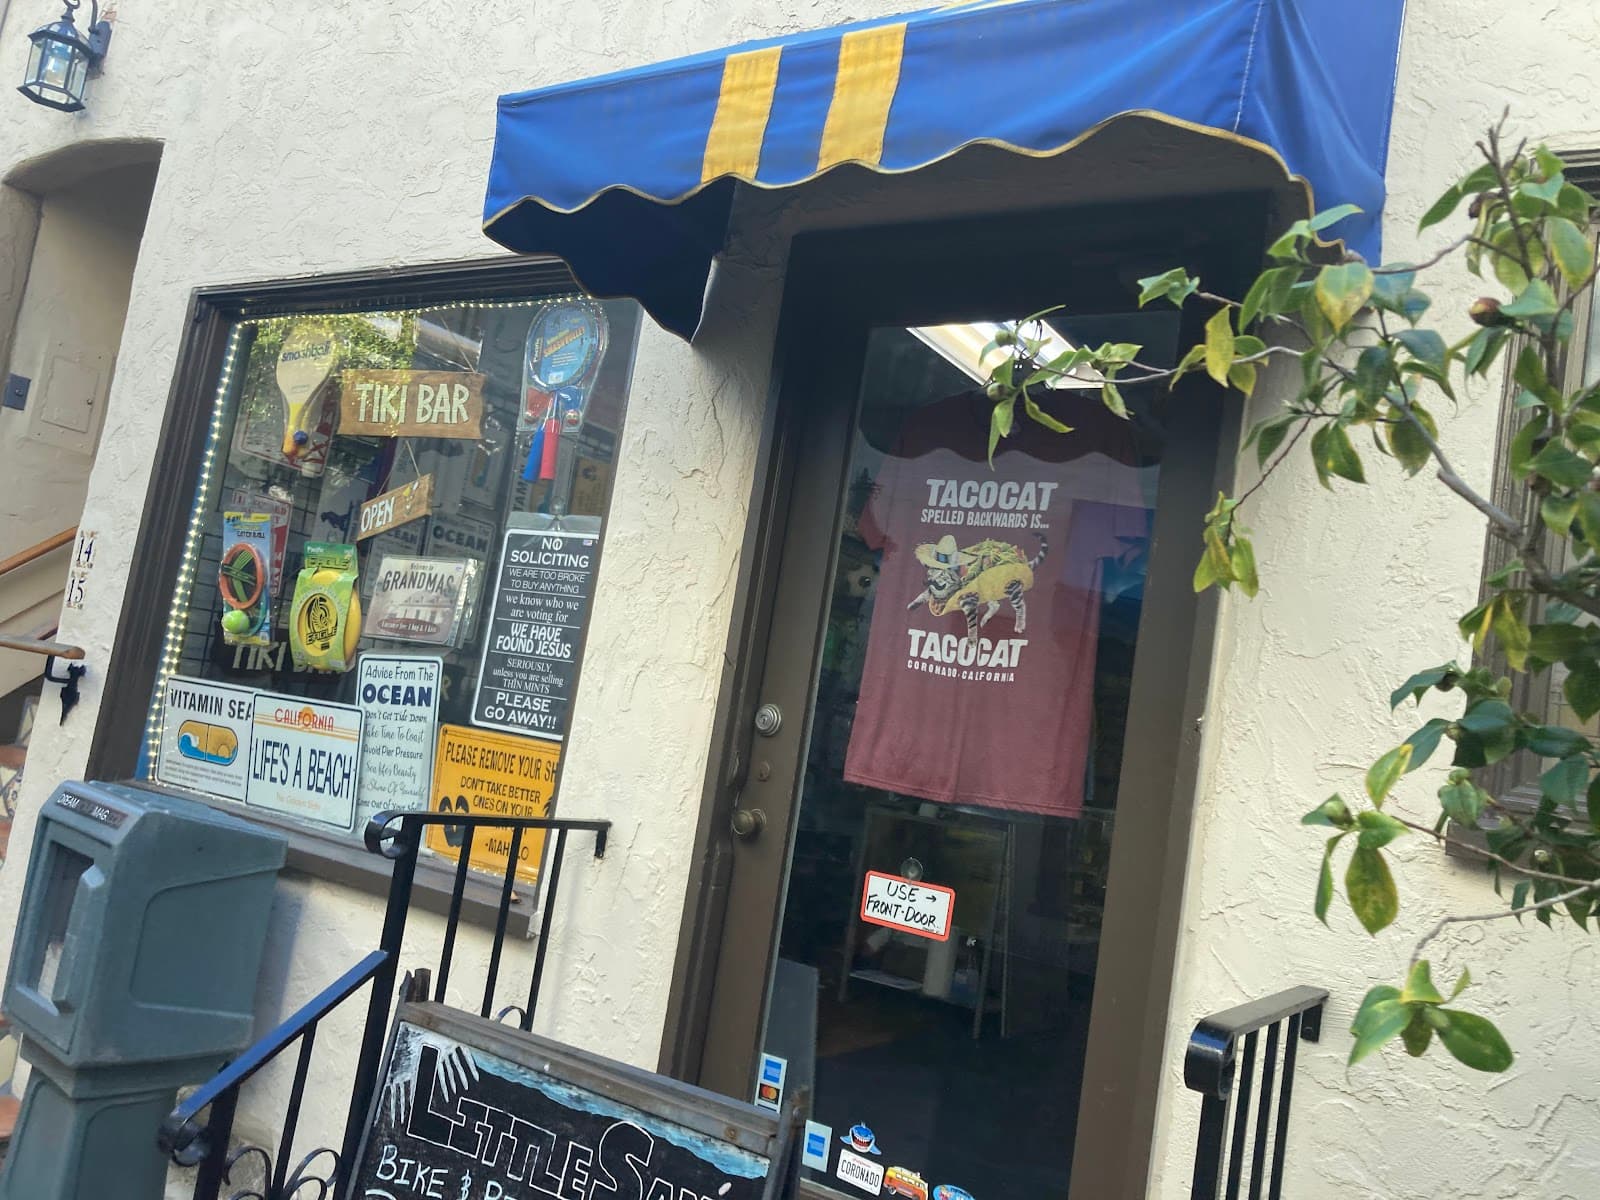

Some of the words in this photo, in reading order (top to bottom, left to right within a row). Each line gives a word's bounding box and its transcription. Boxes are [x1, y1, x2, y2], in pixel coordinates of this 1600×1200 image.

[281, 340, 331, 362] smashball
[355, 383, 407, 424] TIKI
[416, 383, 469, 424] BAR
[926, 478, 1059, 511] TACOCAT
[360, 496, 395, 532] OPEN
[920, 509, 964, 525] SPELLED
[967, 511, 1028, 529] BACKWARDS
[1030, 513, 1050, 529] IS...
[77, 538, 95, 562] 14
[433, 525, 489, 553] OCEAN
[541, 537, 563, 550] NO
[510, 550, 589, 568] SOLICITING
[382, 570, 454, 595] GRANDMAS
[509, 567, 521, 577] WE
[523, 569, 538, 579] ARE
[540, 570, 556, 581] TOO
[558, 573, 586, 583] BROKE
[68, 579, 86, 604] 15
[511, 579, 522, 588] TO
[522, 580, 539, 590] BUY
[540, 582, 579, 594] ANYTHING
[506, 595, 519, 603] we
[520, 593, 543, 606] know
[545, 597, 564, 609] who
[566, 601, 579, 611] we
[510, 608, 525, 618] are
[526, 608, 553, 624] voting
[555, 611, 569, 623] for
[306, 626, 338, 645] EAGLE
[511, 622, 528, 639] WE
[530, 625, 562, 642] HAVE
[496, 635, 534, 654] FOUND
[535, 641, 572, 658] JESUS
[908, 628, 1029, 668] TACOCAT
[365, 665, 393, 679] Advice
[395, 666, 416, 680] From
[418, 667, 434, 681] The
[507, 659, 552, 673] SERIOUSLY,
[493, 668, 514, 678] unless
[514, 672, 527, 682] you
[529, 673, 540, 682] are
[541, 675, 564, 687] selling
[503, 679, 521, 689] THIN
[523, 681, 550, 694] MINTS
[170, 688, 223, 718] VITAMIN
[362, 683, 432, 707] OCEAN
[495, 691, 551, 713] PLEASE
[274, 708, 335, 731] CALIFORNIA
[382, 711, 392, 720] Get
[409, 713, 427, 723] Down
[485, 705, 505, 719] GO
[507, 710, 557, 730] AWAY!!
[365, 723, 378, 738] Take
[381, 725, 394, 740] Time
[397, 726, 405, 739] To
[406, 728, 424, 744] Coast
[395, 746, 423, 759] Pressure
[445, 741, 478, 767] PLEASE
[479, 748, 516, 775] REMOVE
[518, 755, 542, 780] YOUR
[253, 738, 290, 786] LIFE'S
[292, 745, 302, 789] A
[306, 748, 352, 800] BEACH
[393, 763, 417, 784] Beauty
[57, 793, 80, 808] DREAM
[460, 776, 484, 791] DON'T
[484, 780, 508, 797] TAKE
[508, 786, 541, 804] BETTER
[473, 795, 495, 811] ONES
[495, 800, 508, 814] ON
[510, 803, 534, 817] YOUR
[887, 881, 919, 902] USE
[406, 1044, 594, 1200] LITTLE
[376, 1144, 449, 1199] BIKE
[841, 1159, 880, 1189] CORONADO
